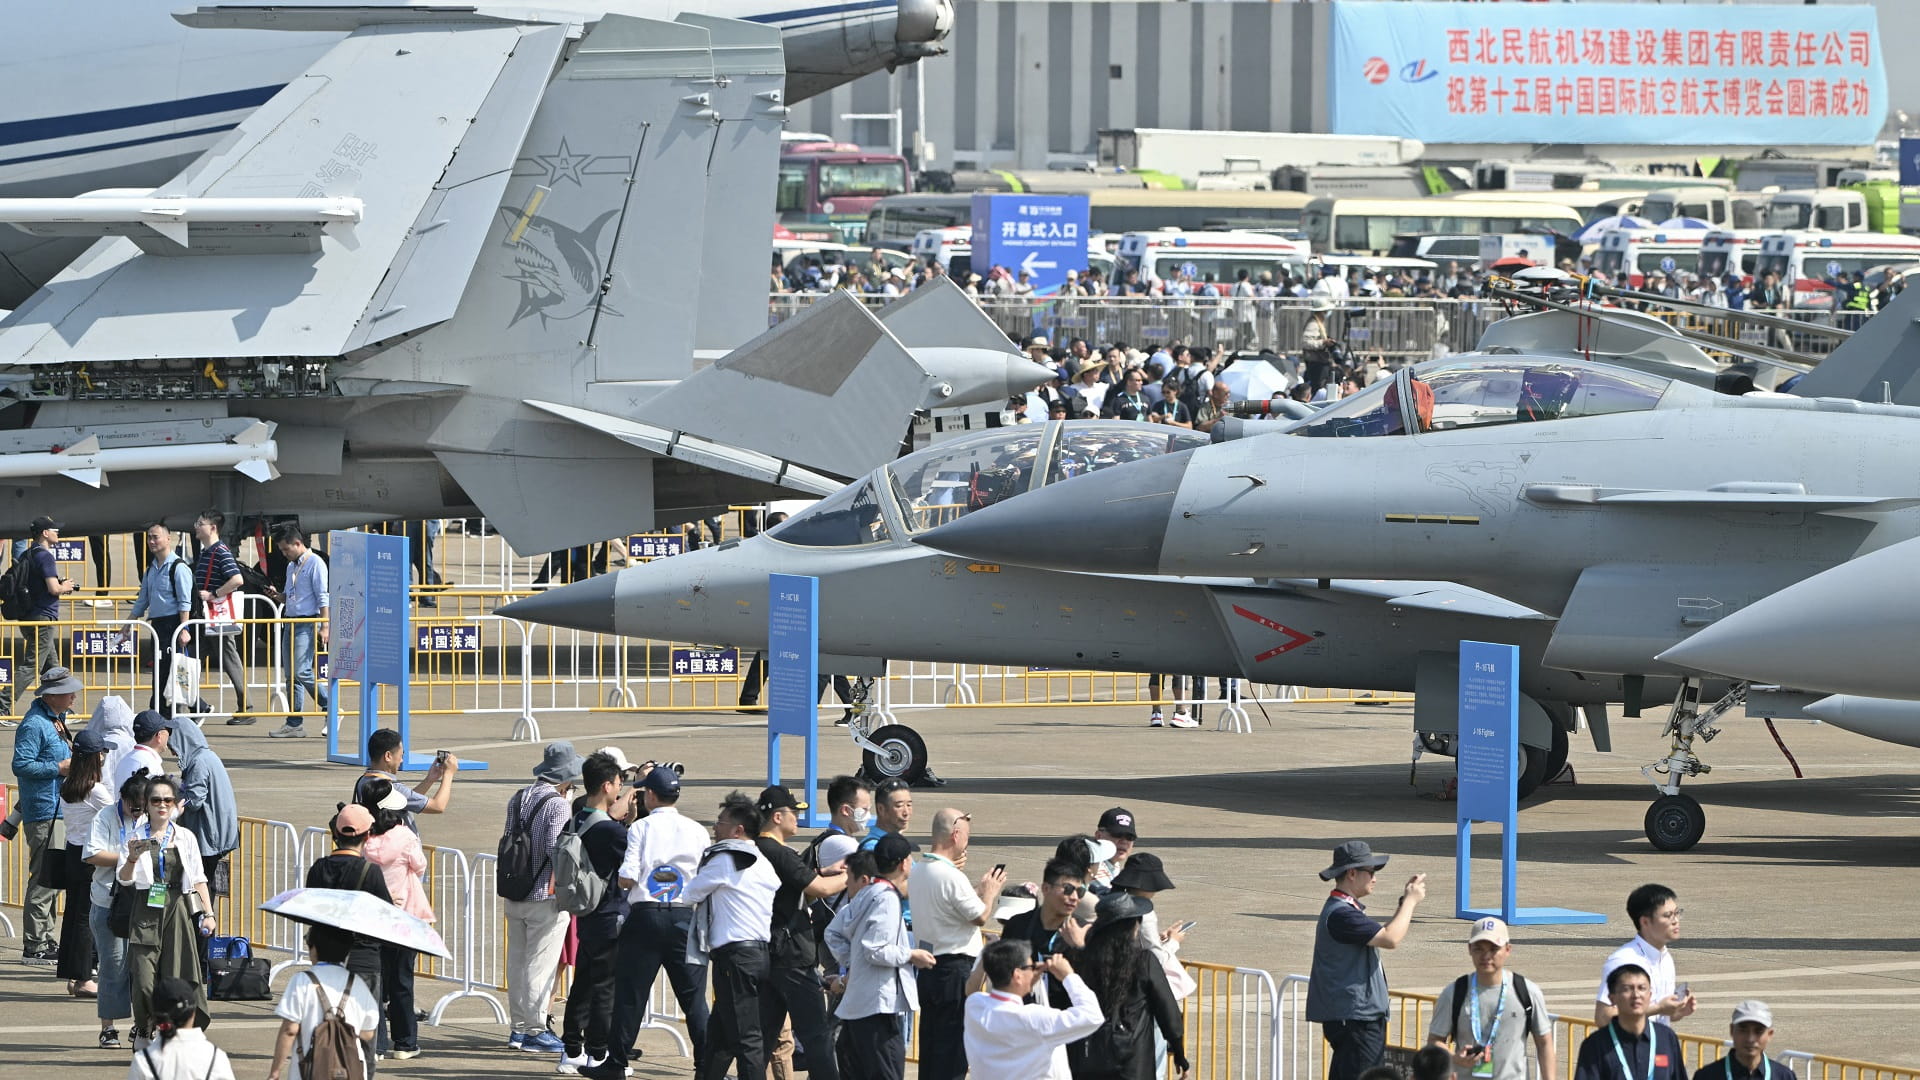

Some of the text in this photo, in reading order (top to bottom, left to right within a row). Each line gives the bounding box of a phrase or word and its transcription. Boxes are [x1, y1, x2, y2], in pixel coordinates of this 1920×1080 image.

[1446, 28, 1870, 67] 西北民航机场建设集团有限责任公司
[1446, 76, 1869, 116] 祝第十五届中国国际航空航天博览会圆满成功
[1001, 221, 1078, 238] 开幕式入口
[631, 543, 680, 556] 中国珠海
[420, 635, 476, 649] 中国珠海
[675, 658, 734, 673] 中国珠海
[1481, 920, 1495, 931] 18
